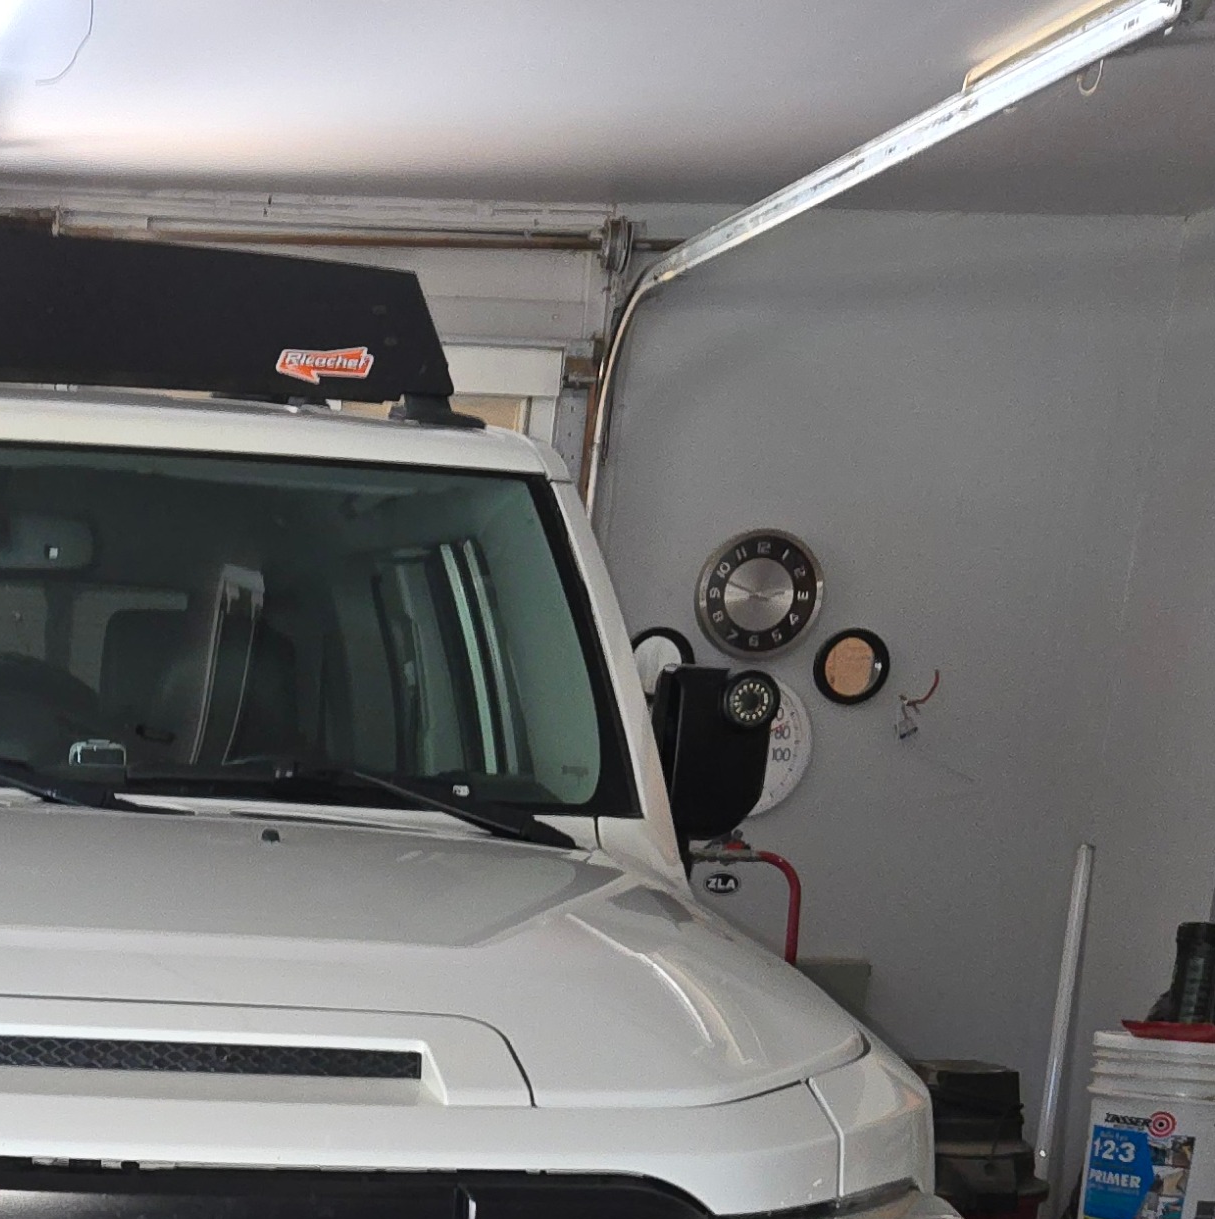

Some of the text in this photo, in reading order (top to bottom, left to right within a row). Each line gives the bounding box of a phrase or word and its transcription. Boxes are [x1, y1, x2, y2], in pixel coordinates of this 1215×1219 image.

[716, 561, 731, 579] 10
[712, 610, 724, 623] 8
[789, 612, 800, 626] 4
[727, 628, 739, 639] 7
[774, 725, 791, 740] 80
[771, 747, 792, 762] 100
[707, 878, 736, 890] ZLA
[1088, 1168, 1141, 1188] PRIMER
